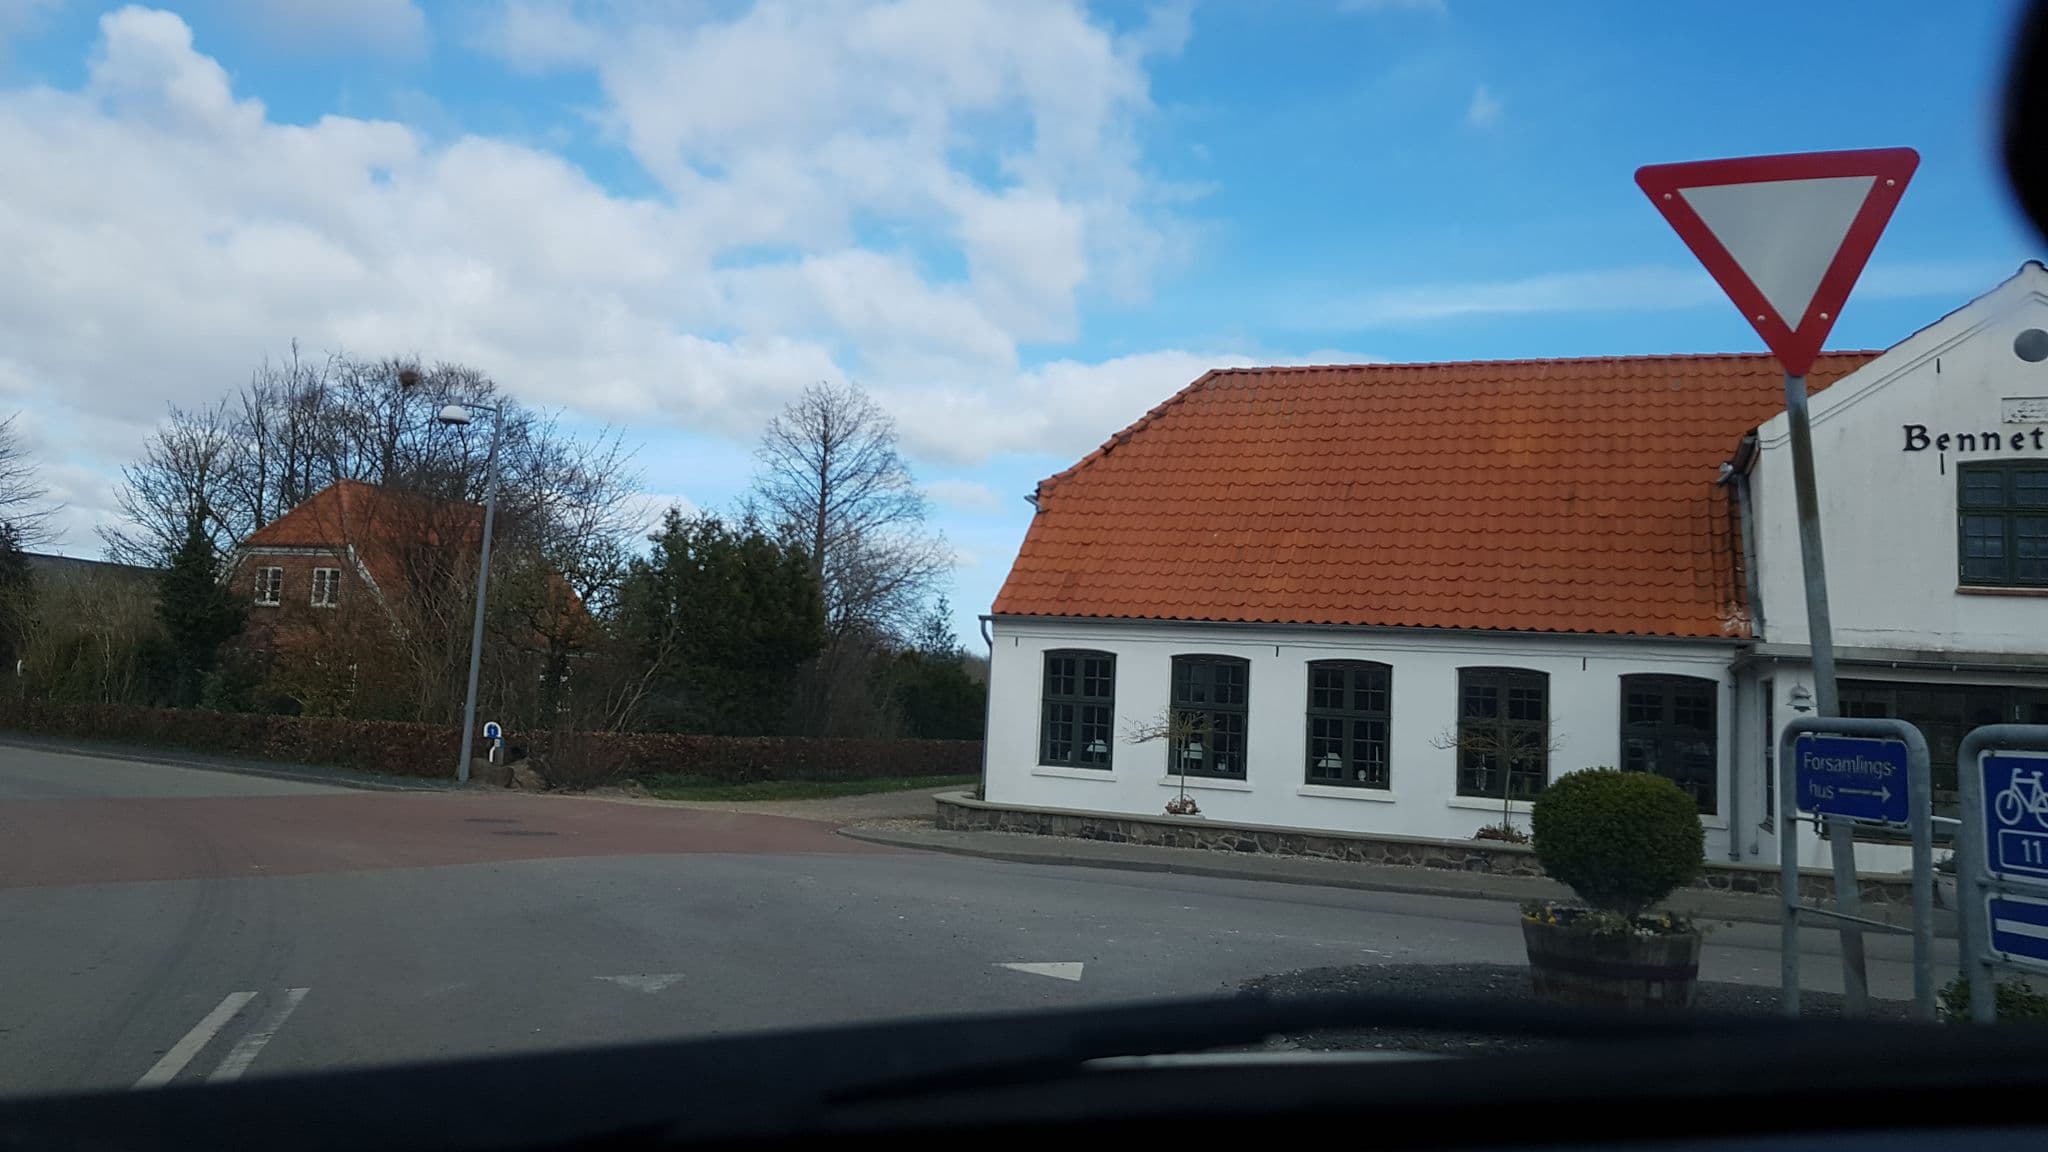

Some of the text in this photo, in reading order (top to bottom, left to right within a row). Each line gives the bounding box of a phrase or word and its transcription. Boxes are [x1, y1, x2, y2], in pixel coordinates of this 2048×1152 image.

[1903, 424, 2044, 451] Bennet
[1808, 779, 1834, 799] hus
[2021, 839, 2042, 864] 11
